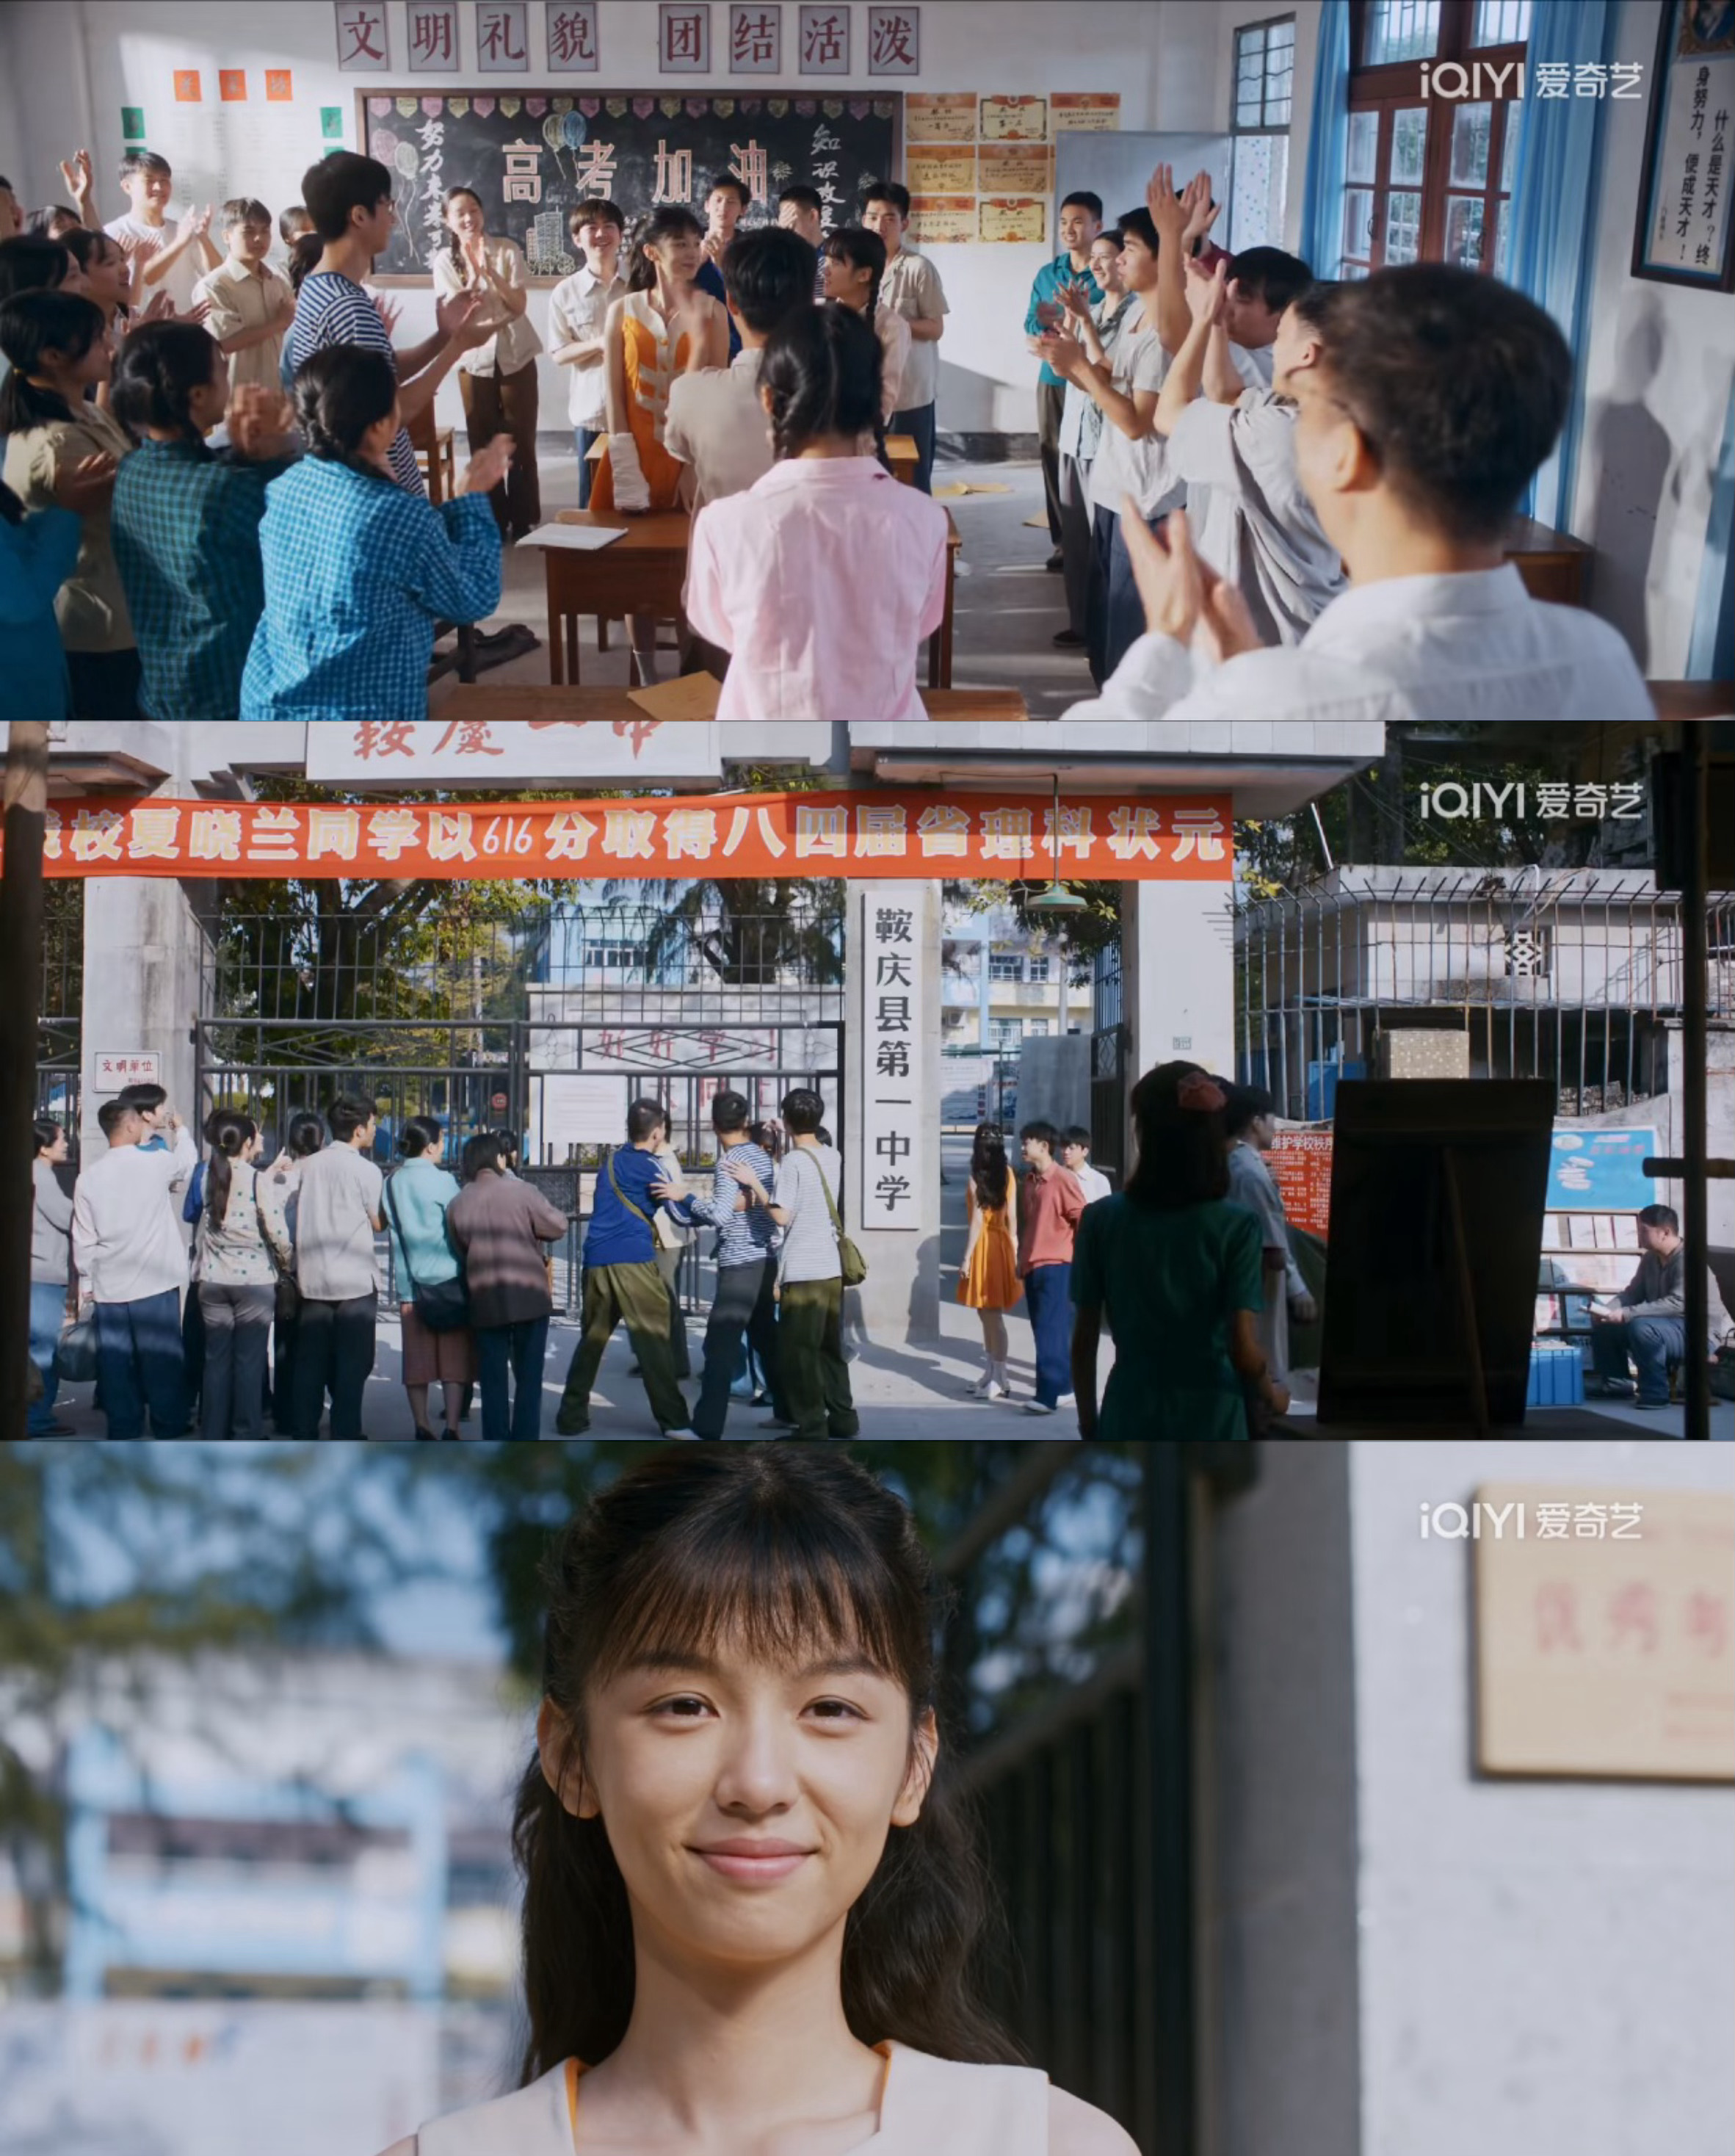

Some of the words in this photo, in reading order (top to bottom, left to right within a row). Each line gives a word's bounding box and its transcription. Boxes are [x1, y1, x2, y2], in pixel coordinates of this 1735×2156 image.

[342, 12, 595, 62] 文明礼貌
[666, 13, 916, 65] 团结活泼
[502, 138, 767, 204] 高考加油
[811, 123, 846, 238] 知识改变
[875, 908, 913, 1212] 鞍庆县第一中学
